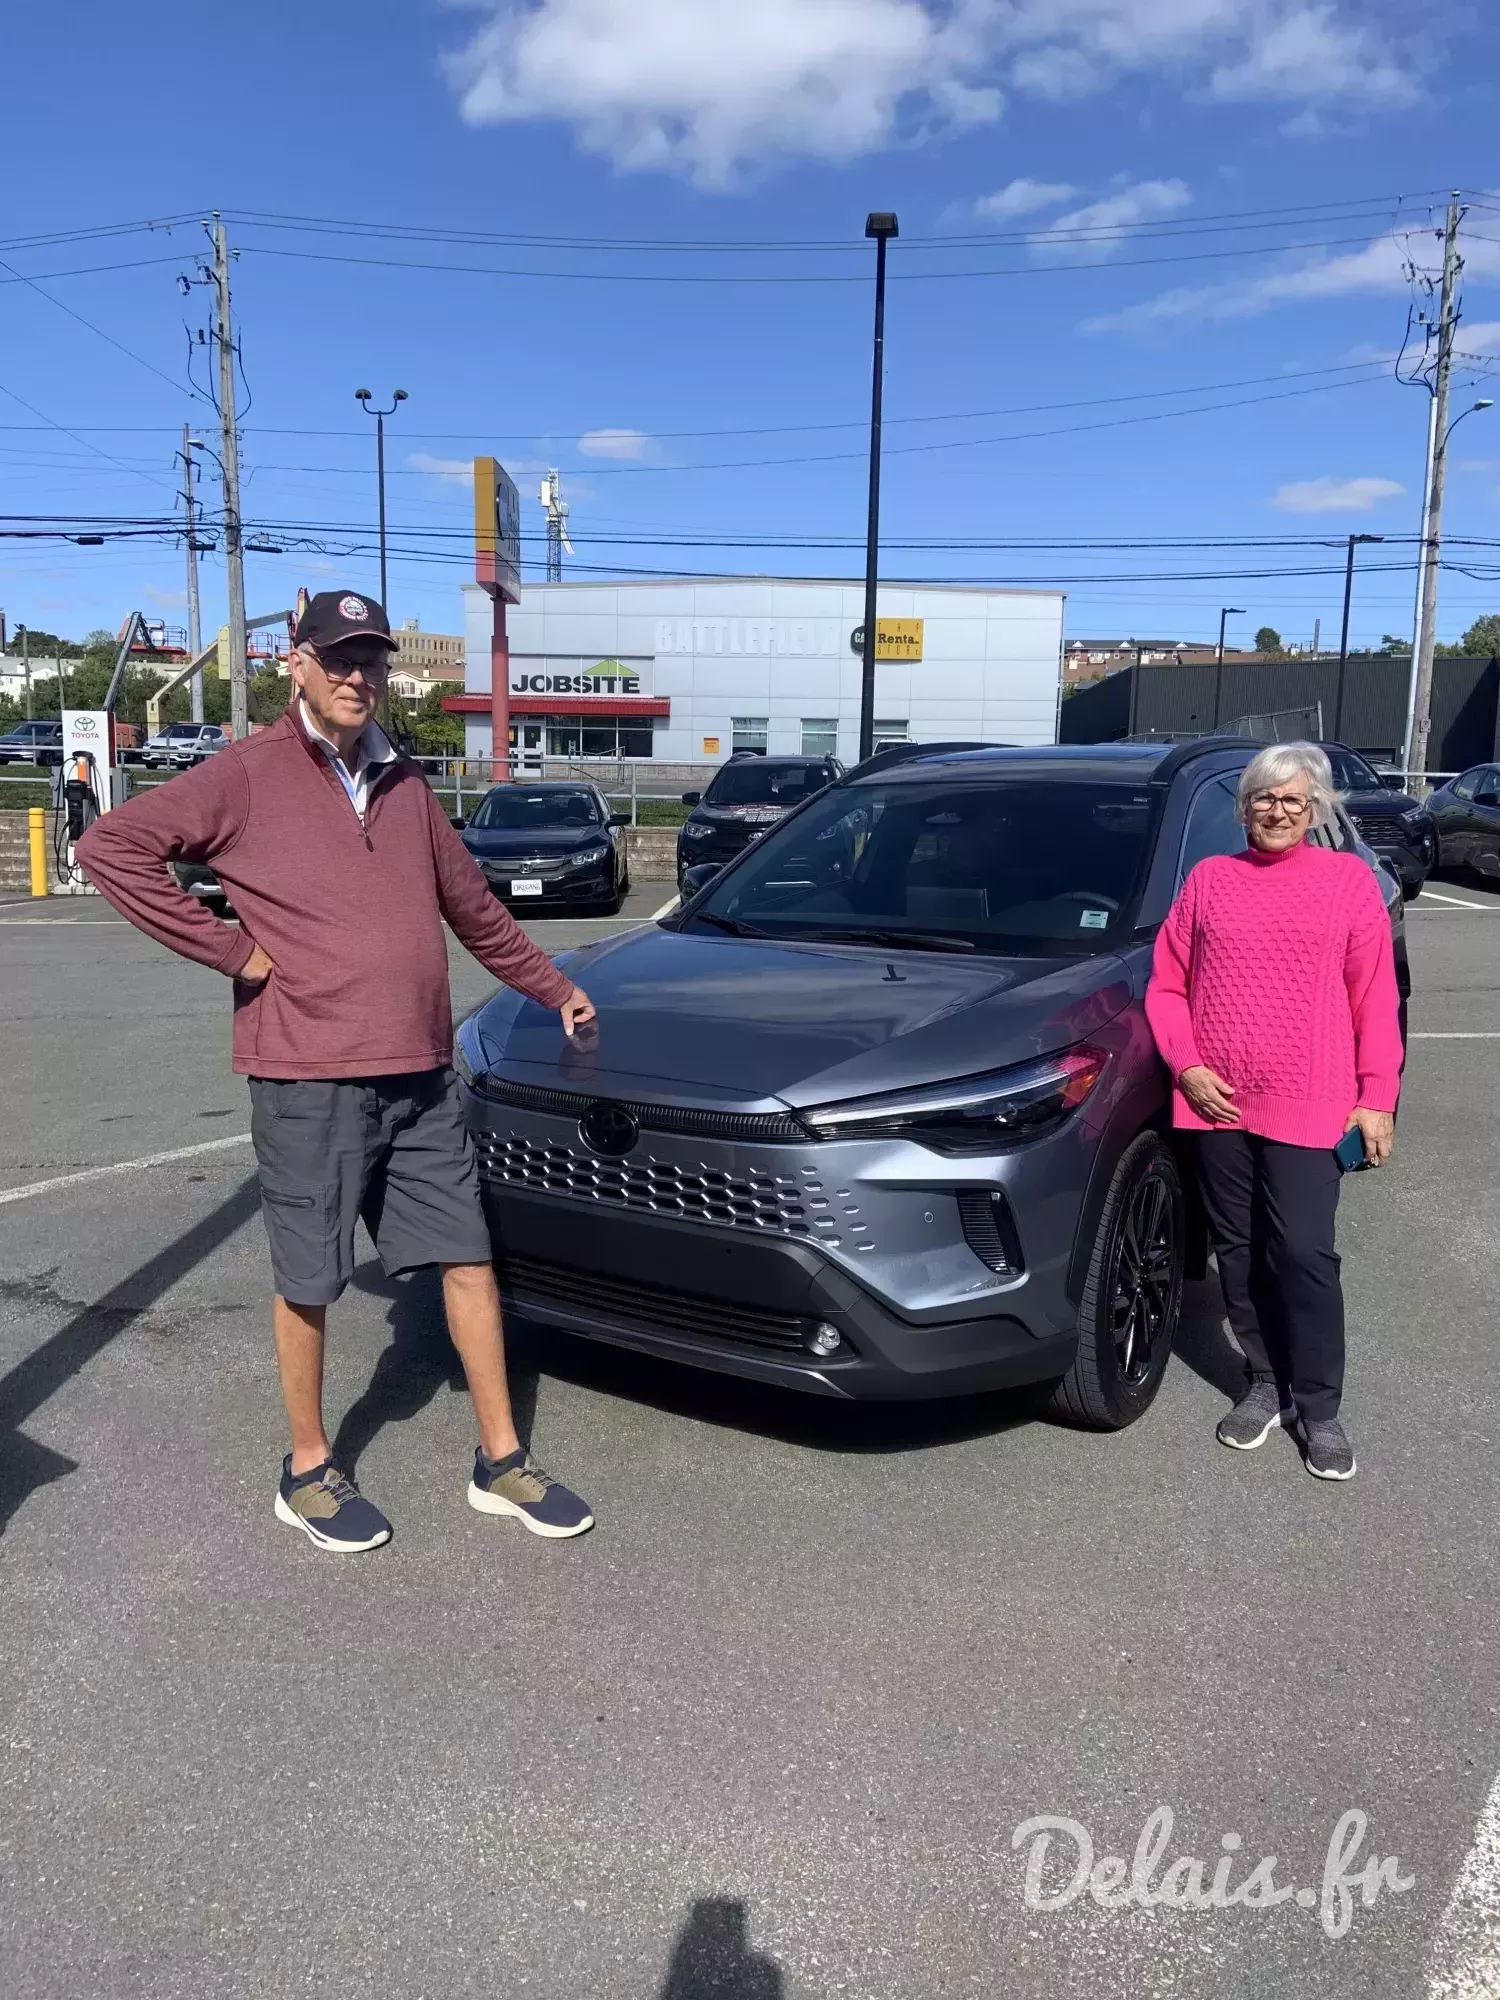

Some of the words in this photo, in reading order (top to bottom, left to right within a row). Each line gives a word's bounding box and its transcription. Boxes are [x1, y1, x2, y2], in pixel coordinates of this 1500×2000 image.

[655, 620, 838, 655] BATTLEFIELD
[854, 632, 865, 643] CA
[511, 674, 640, 694] JOBSITE
